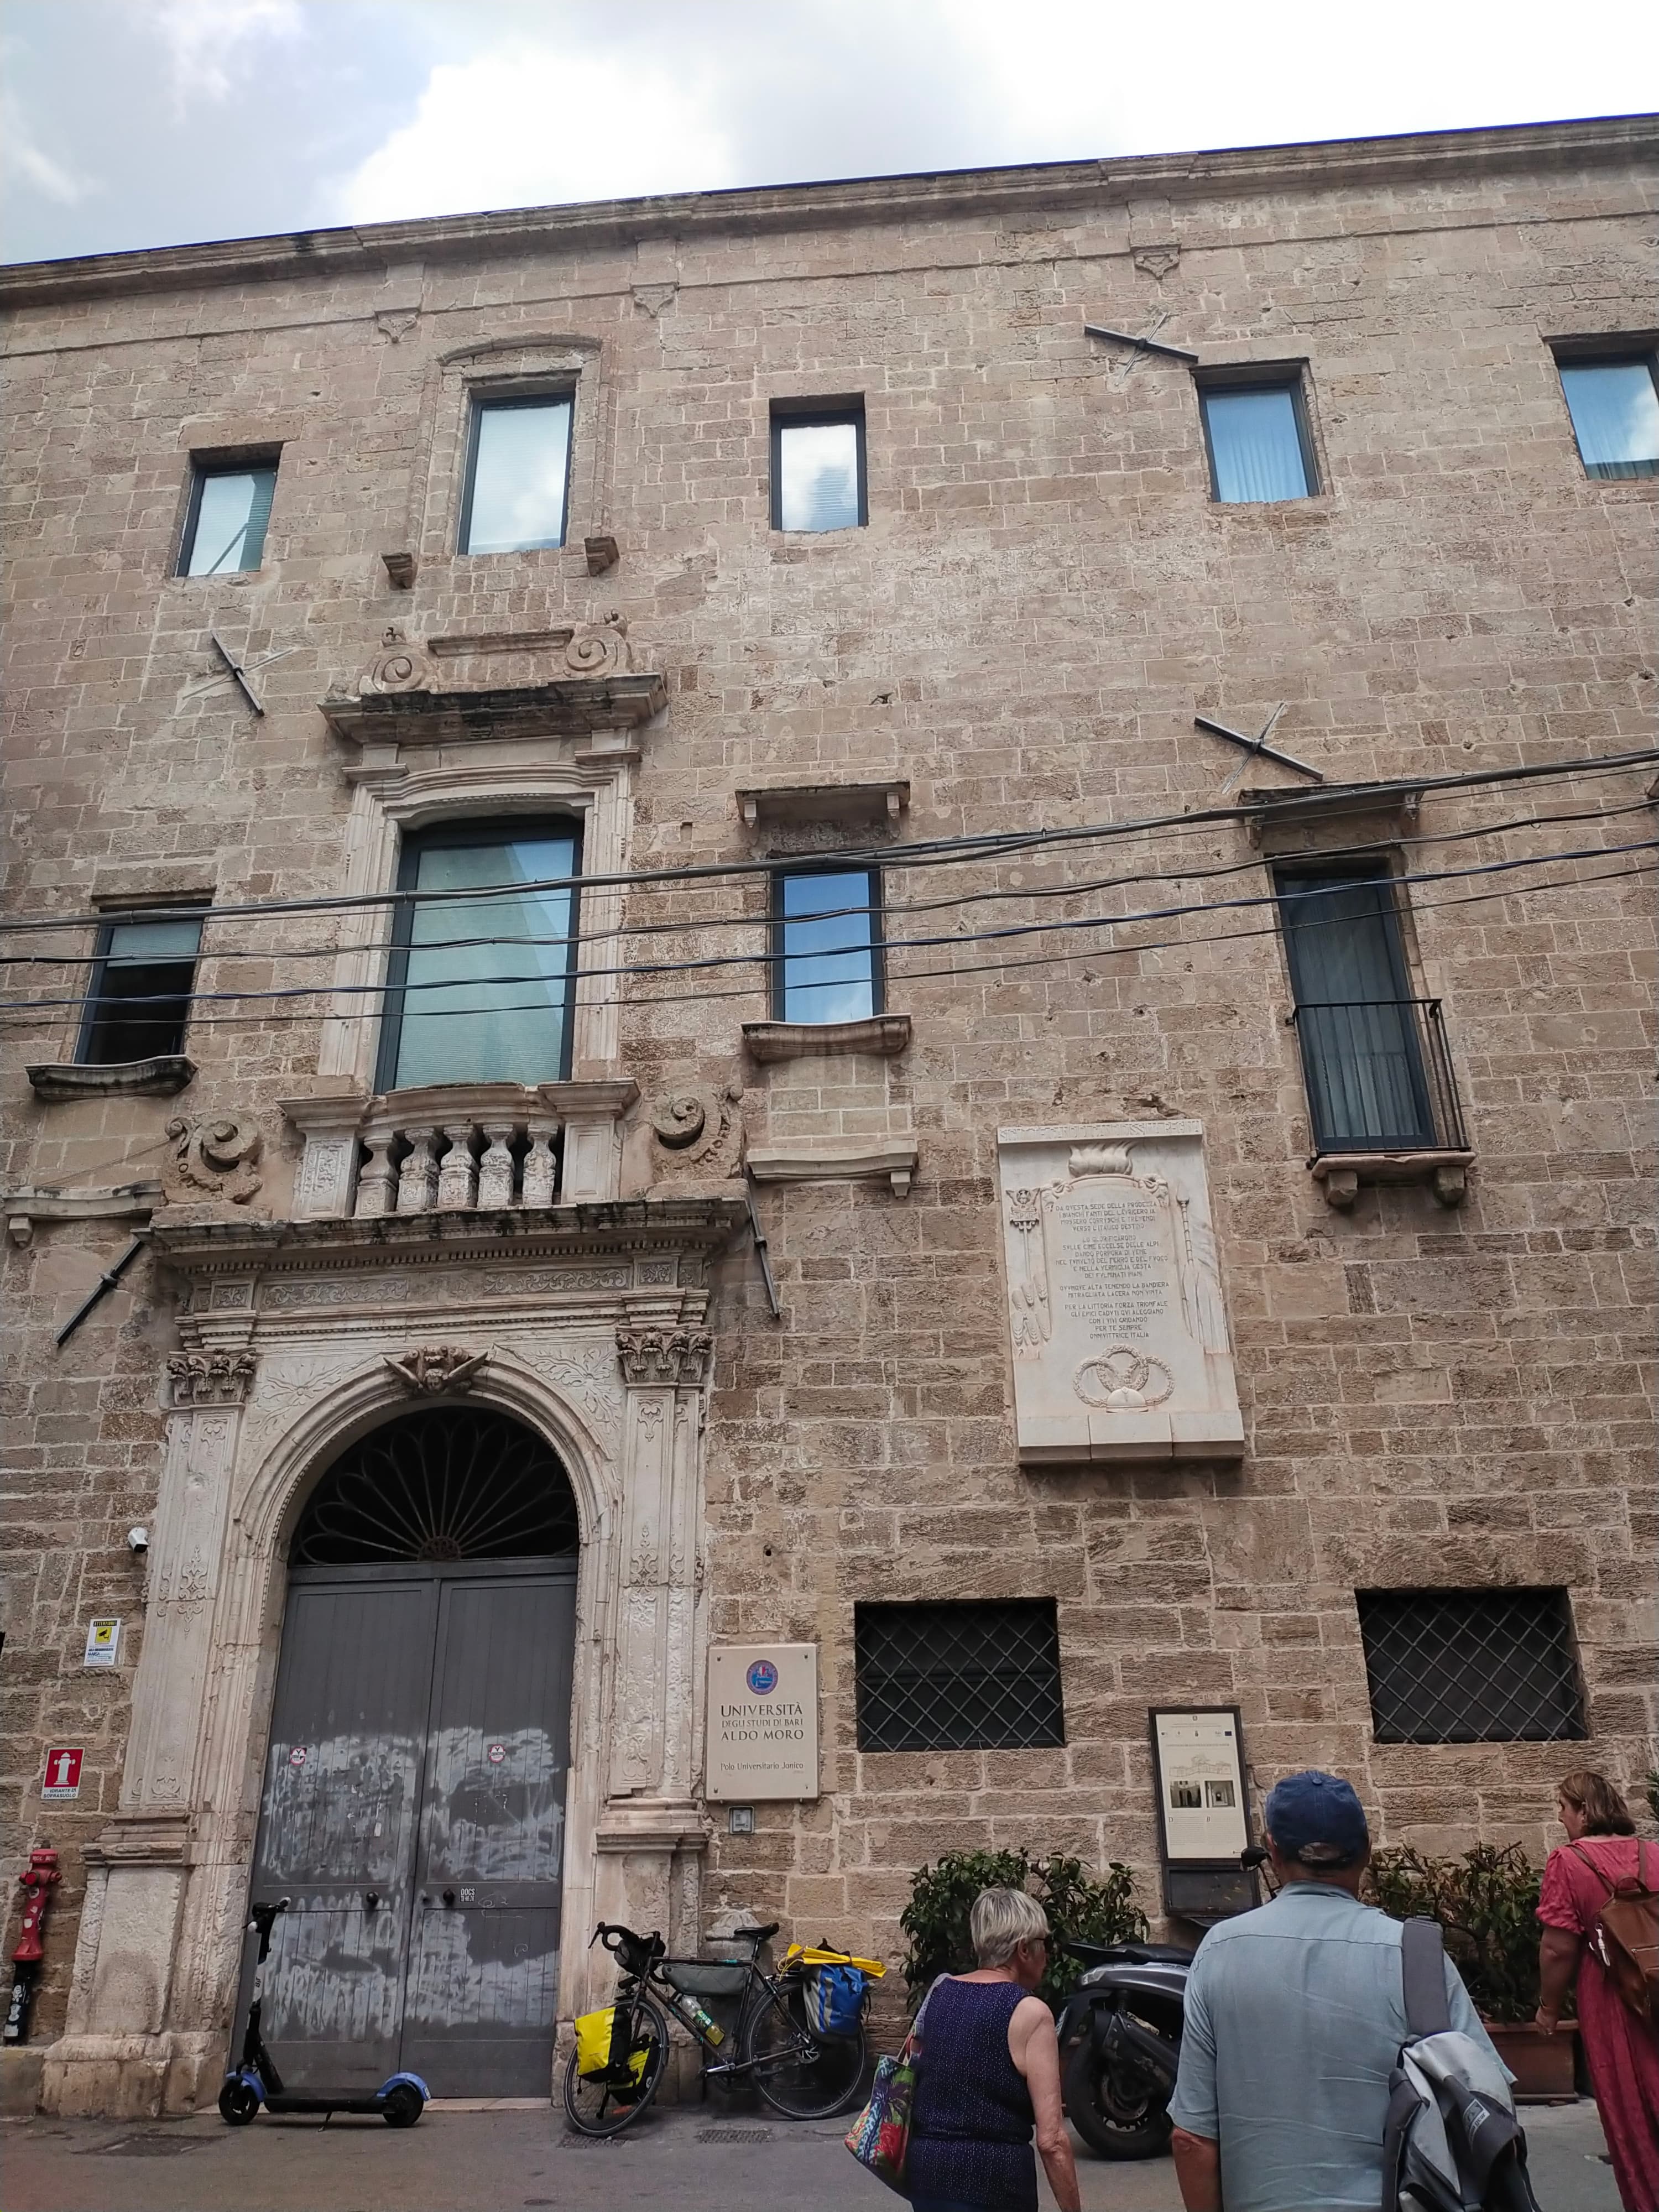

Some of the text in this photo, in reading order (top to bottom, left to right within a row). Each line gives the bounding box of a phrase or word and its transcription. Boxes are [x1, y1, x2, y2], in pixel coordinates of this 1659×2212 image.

[721, 1702, 802, 1717] UNIVERSITÀ
[721, 1729, 804, 1741] ALDO MORO
